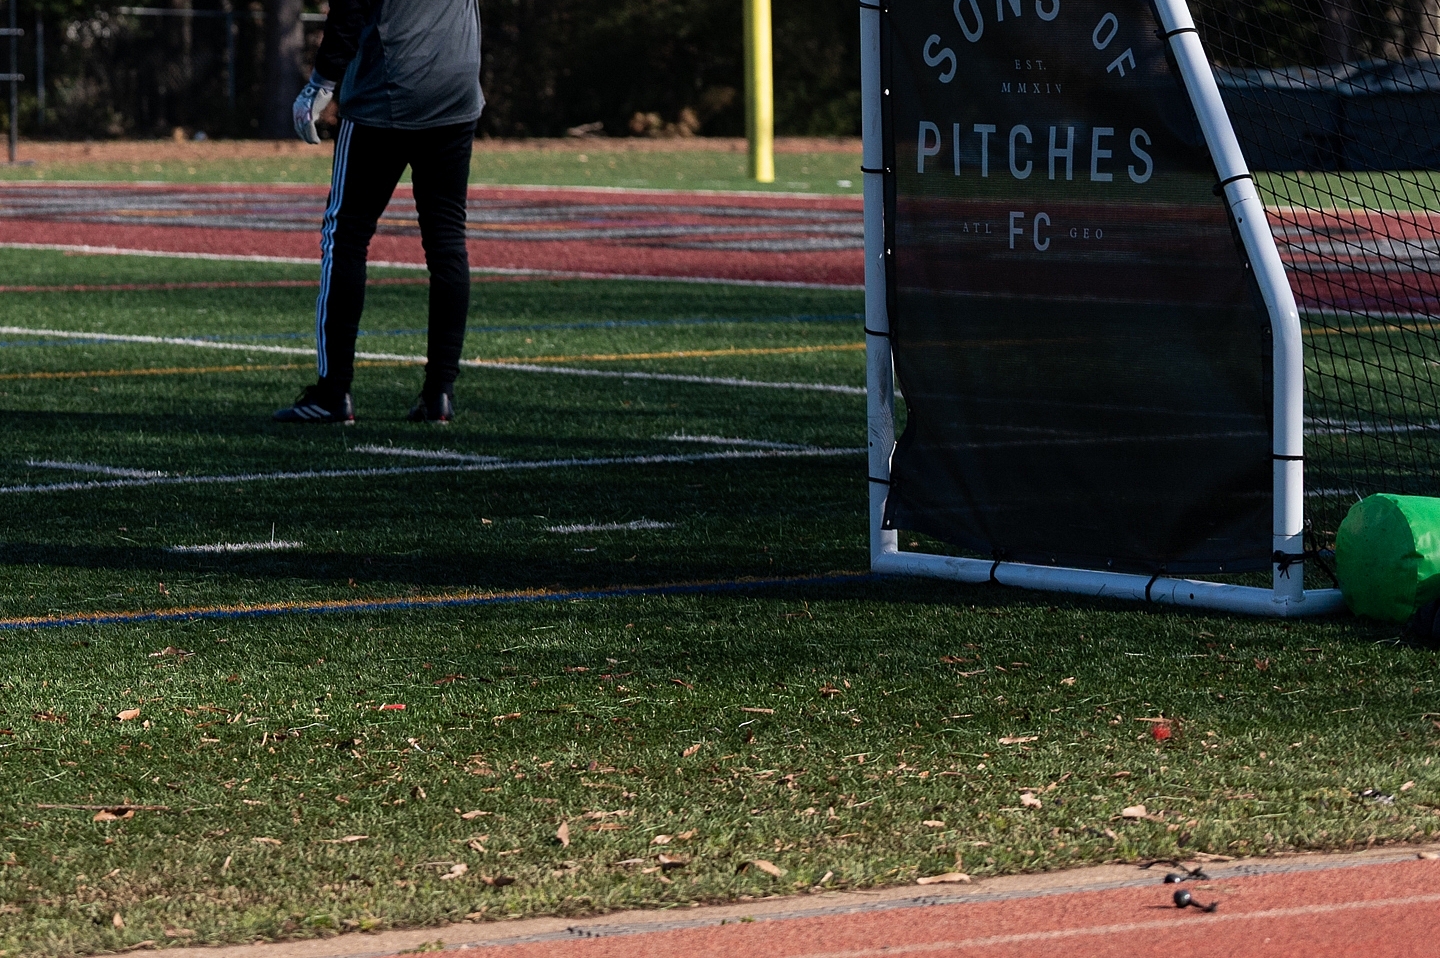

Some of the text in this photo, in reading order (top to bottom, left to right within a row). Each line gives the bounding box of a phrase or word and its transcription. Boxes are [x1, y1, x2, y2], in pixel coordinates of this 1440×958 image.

[1014, 59, 1047, 71] EST.
[1092, 11, 1137, 78] OF
[917, 120, 1154, 184] PITCHES
[962, 211, 1103, 252] ATL FC GEO
